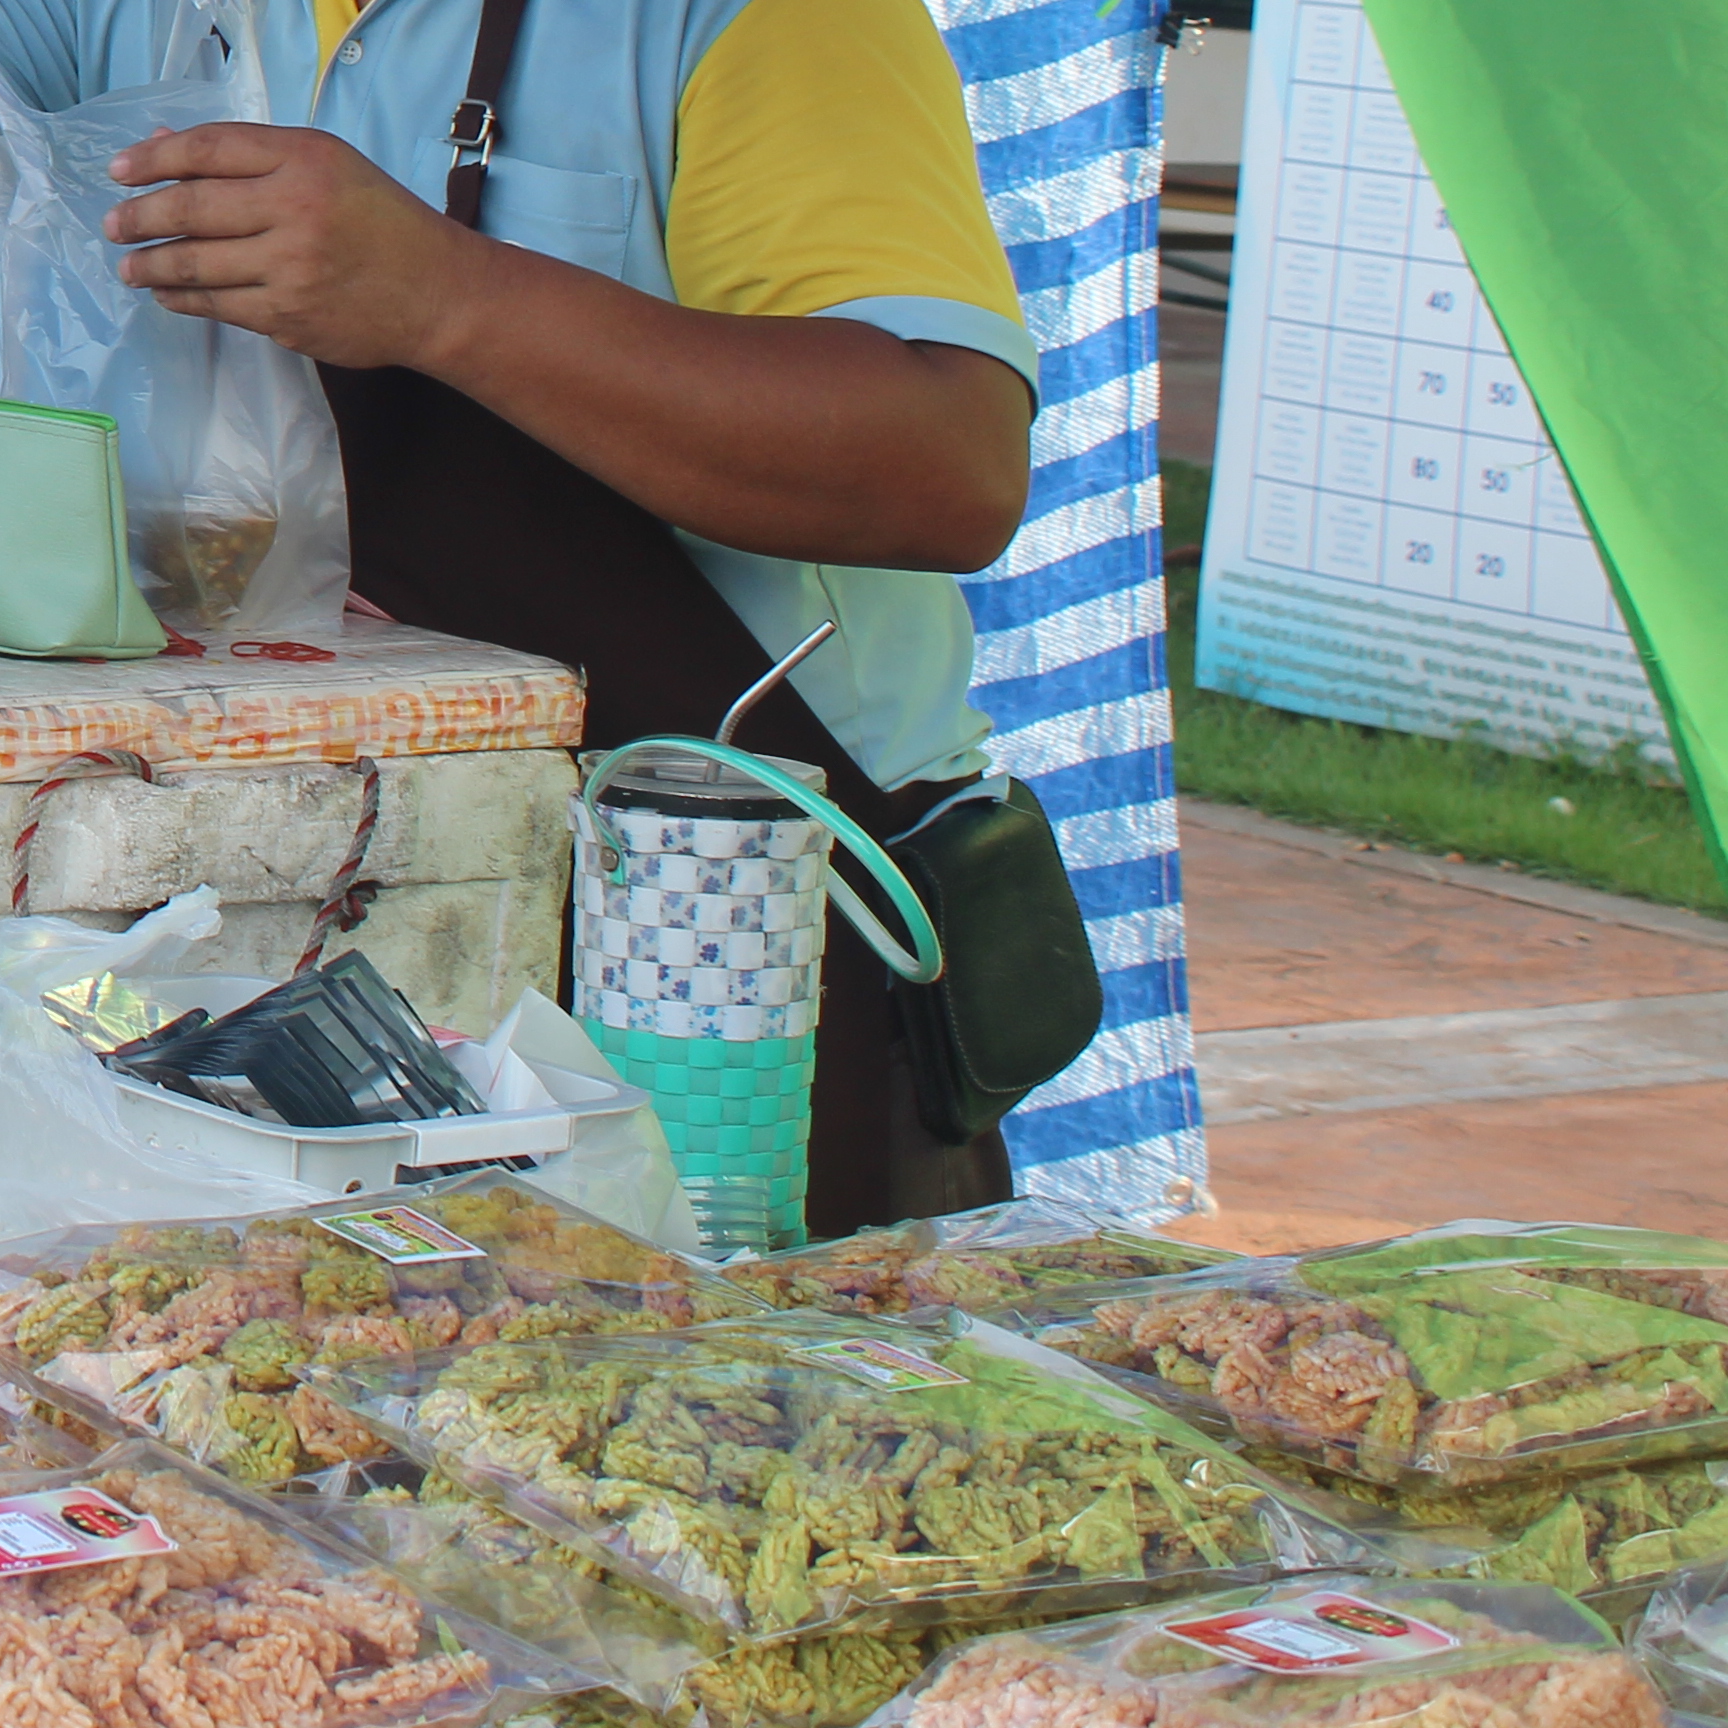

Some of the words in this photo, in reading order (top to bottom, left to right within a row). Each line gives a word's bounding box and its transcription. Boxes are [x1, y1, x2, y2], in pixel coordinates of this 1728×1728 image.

[1425, 288, 1455, 313] 40
[1417, 371, 1447, 396] 70
[1488, 381, 1518, 406] 50
[1411, 457, 1440, 481] 80
[1480, 469, 1510, 494] 50
[1405, 540, 1434, 565] 20
[1475, 553, 1506, 578] 20
